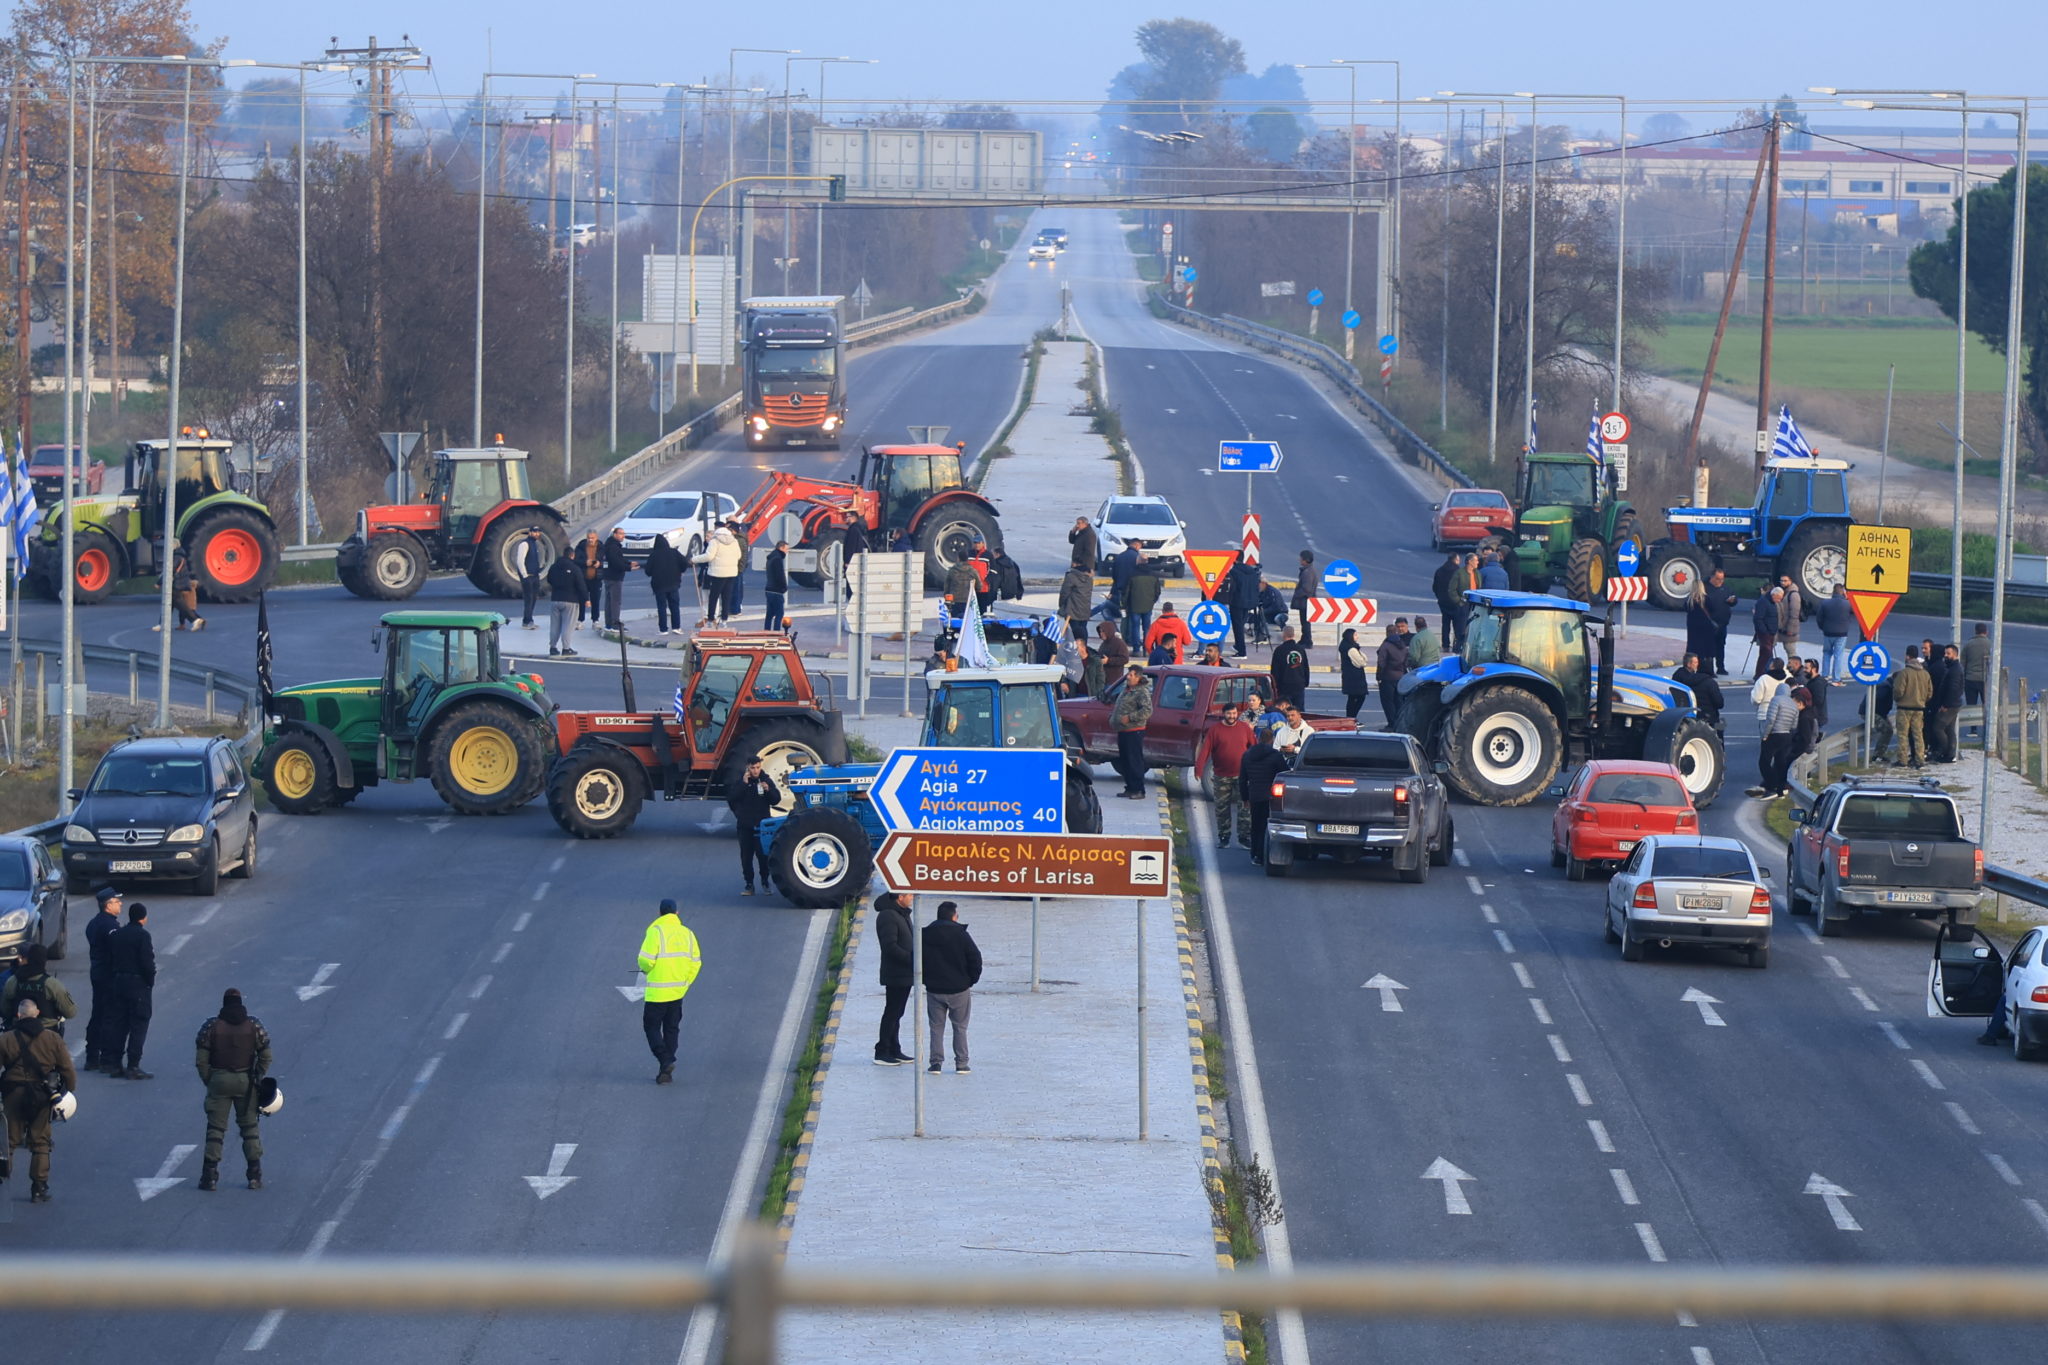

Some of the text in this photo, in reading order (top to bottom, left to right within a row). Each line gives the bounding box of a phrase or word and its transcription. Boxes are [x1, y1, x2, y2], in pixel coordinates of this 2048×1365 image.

[1860, 532, 1899, 544] ΑΘΗΝΑ
[1857, 546, 1901, 559] ATHENS
[920, 760, 959, 776] Αγιά
[966, 770, 988, 784] 27
[920, 779, 958, 796] Agia
[919, 797, 1022, 815] Αγιόκαμπος
[1033, 808, 1057, 822] 40
[919, 816, 1024, 831] Agiokampos
[915, 840, 1010, 862] Παραλίες
[1042, 845, 1126, 865] Λάρισας
[915, 864, 1095, 885] Beaches of Larisa
